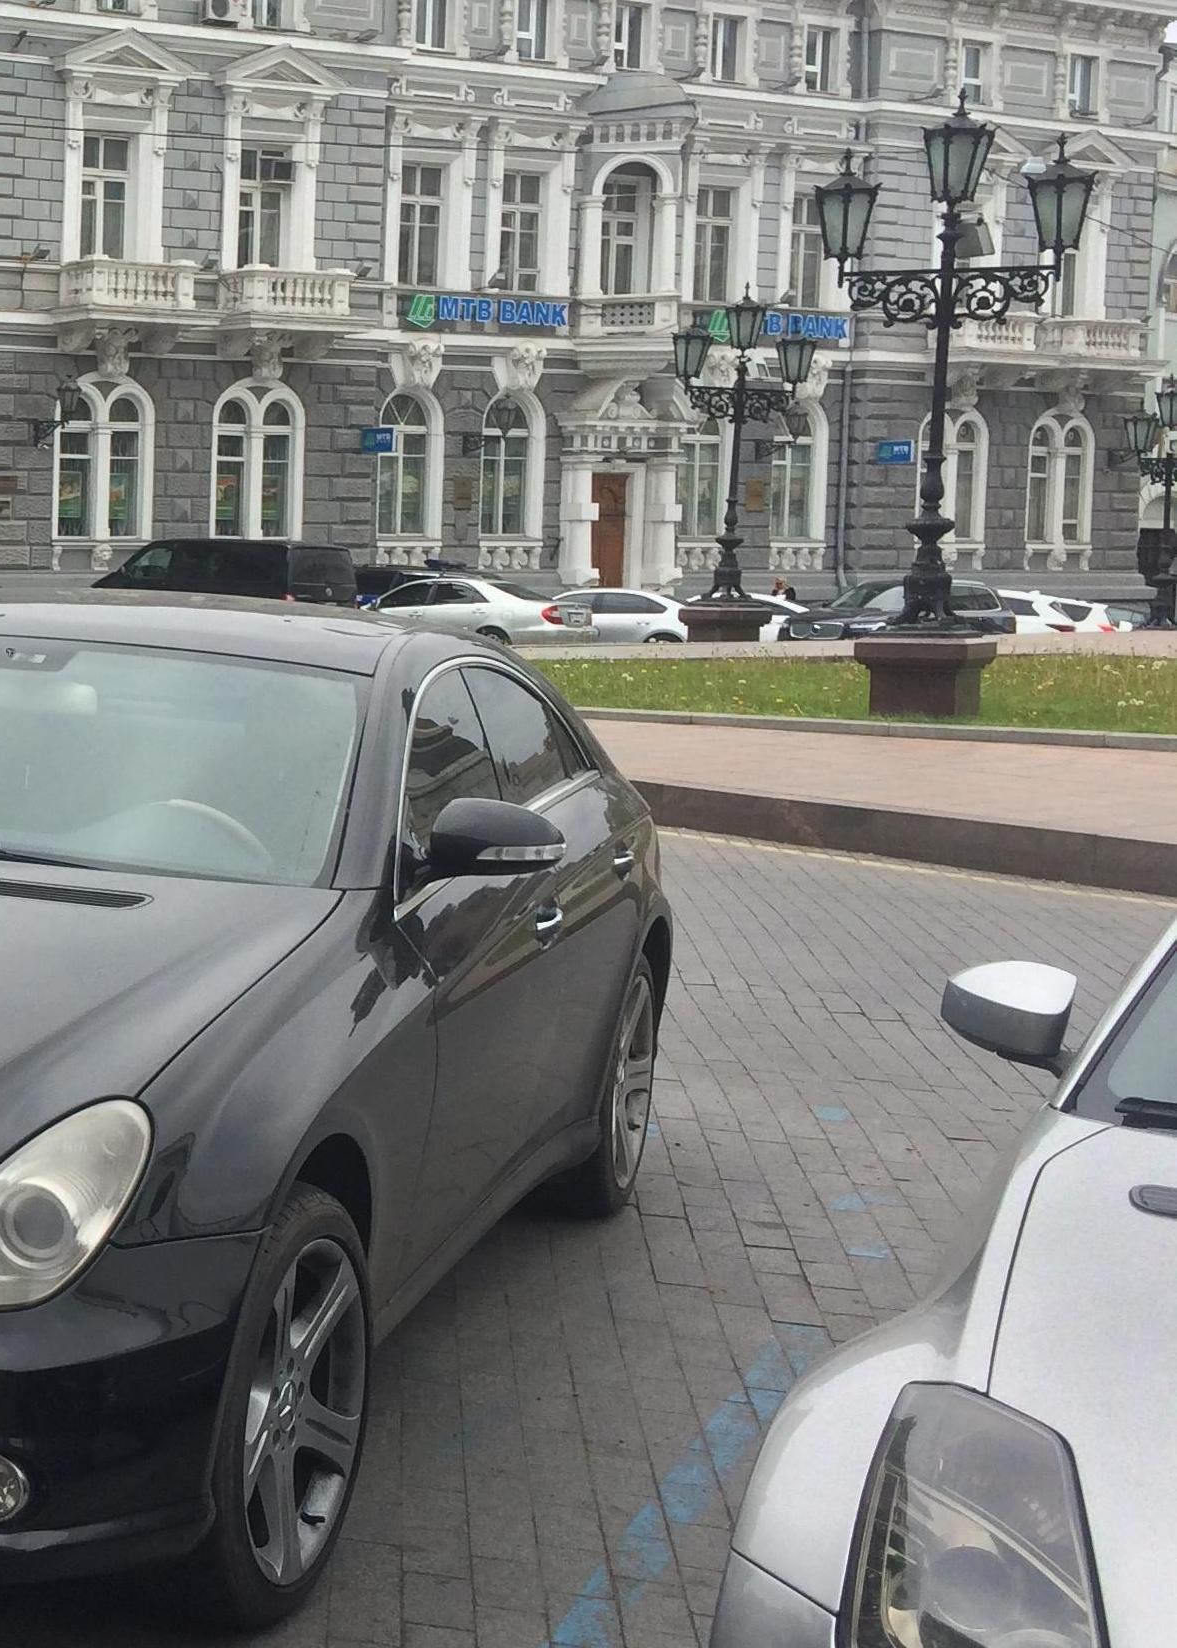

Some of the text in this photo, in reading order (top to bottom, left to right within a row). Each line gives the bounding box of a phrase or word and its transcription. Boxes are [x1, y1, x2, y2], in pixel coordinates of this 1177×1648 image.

[439, 295, 570, 327] MTB BANK
[788, 313, 851, 341] BANK
